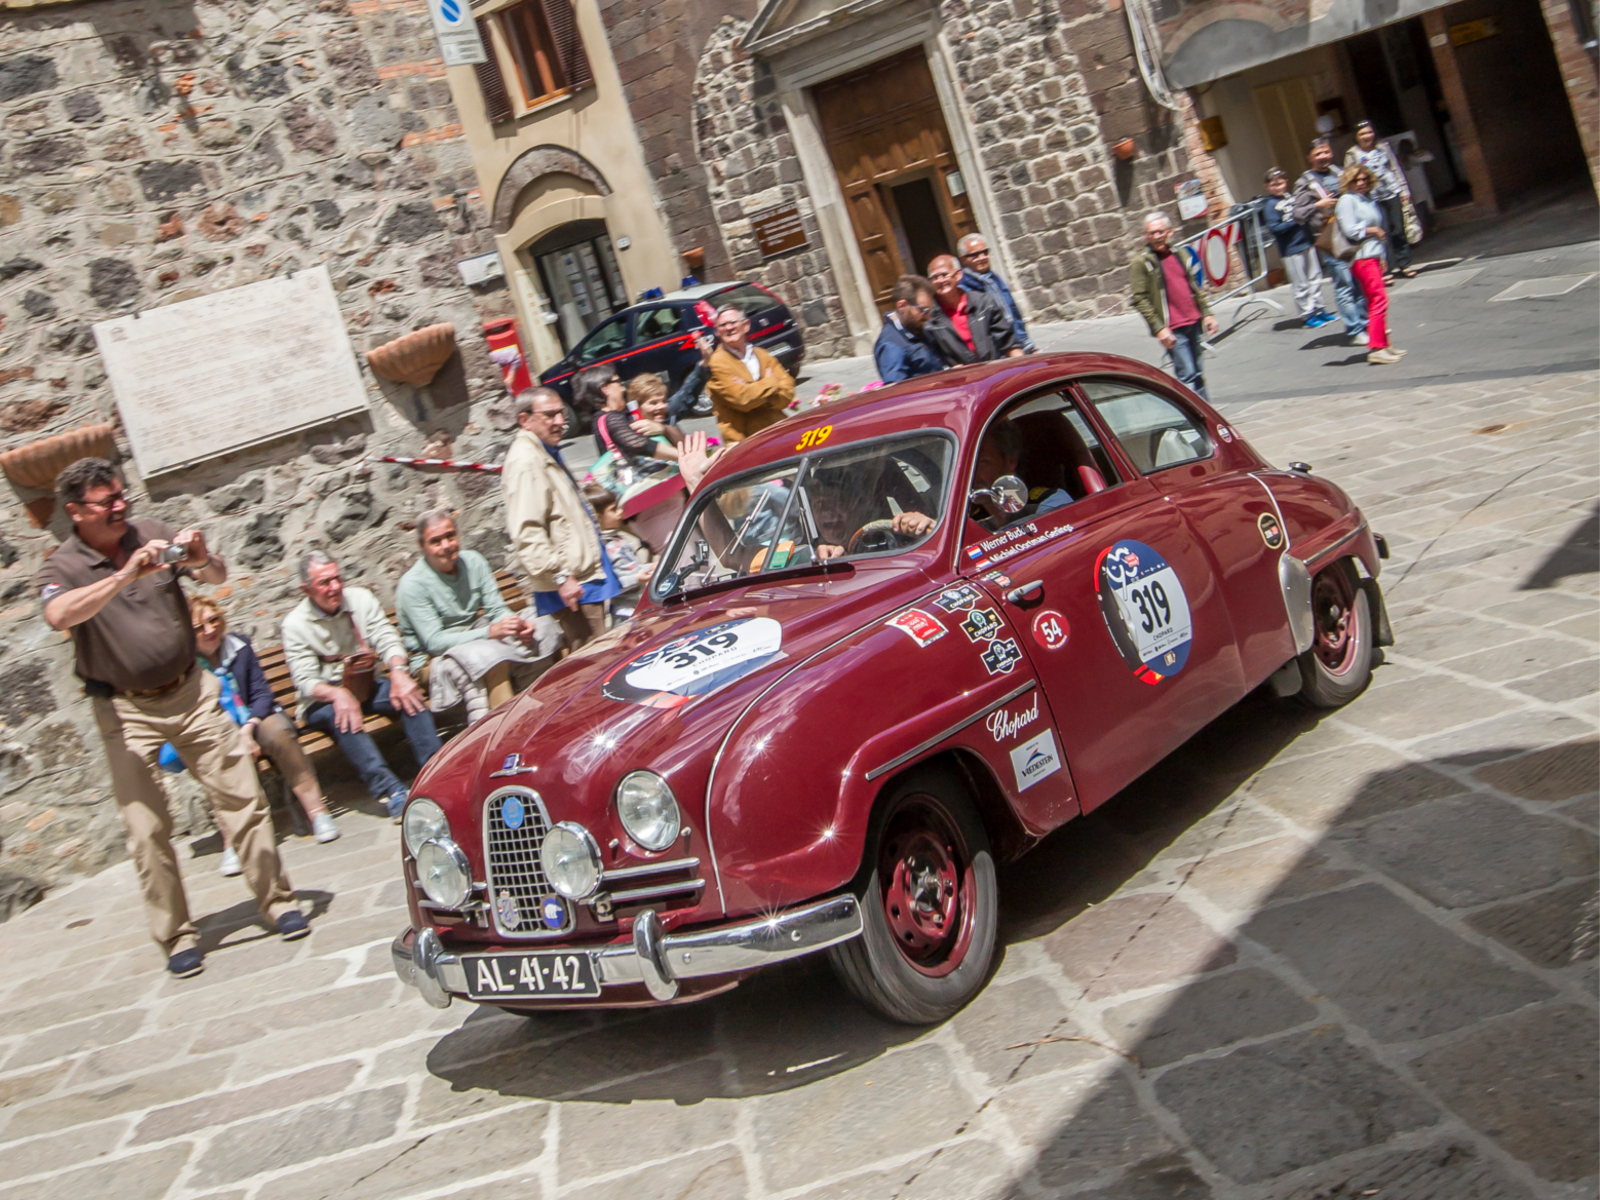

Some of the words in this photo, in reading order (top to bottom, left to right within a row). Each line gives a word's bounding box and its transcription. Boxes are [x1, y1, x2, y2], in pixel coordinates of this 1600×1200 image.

[796, 425, 833, 451] 319
[980, 534, 1009, 552] Werner
[950, 594, 975, 608] CHOPARD
[1131, 580, 1171, 634] 319
[974, 621, 998, 637] CHOPARD
[1041, 618, 1062, 642] 54
[1153, 627, 1173, 640] CHOPARD
[664, 632, 738, 669] 319
[692, 647, 737, 667] CHOPARD
[986, 692, 1039, 742] Chopard
[1021, 754, 1053, 777] VREDESTEIN
